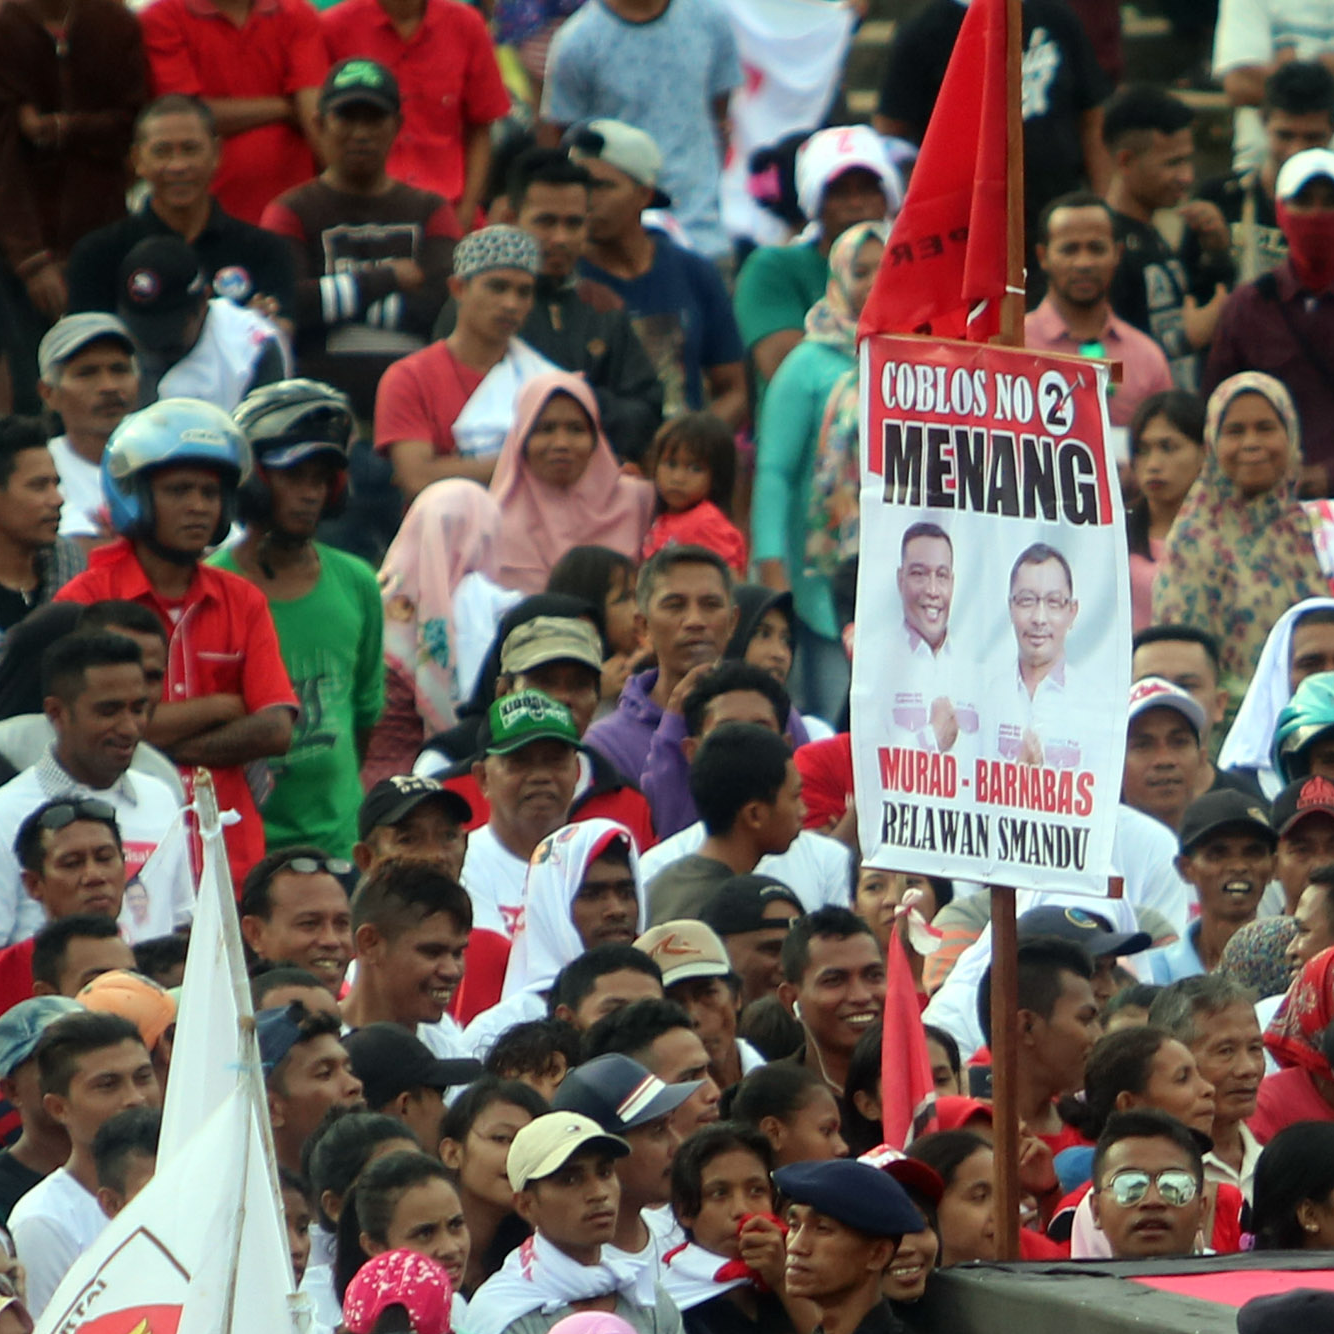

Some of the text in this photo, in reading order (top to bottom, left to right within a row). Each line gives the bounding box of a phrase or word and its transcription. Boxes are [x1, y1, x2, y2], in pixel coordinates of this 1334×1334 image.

[881, 361, 1069, 428] COBLOS NO 2
[881, 421, 1100, 526] MENANG
[878, 746, 957, 800] MURAD
[976, 759, 1096, 818] BARNABAS
[881, 800, 1092, 872] RELAWAN SMANDU
